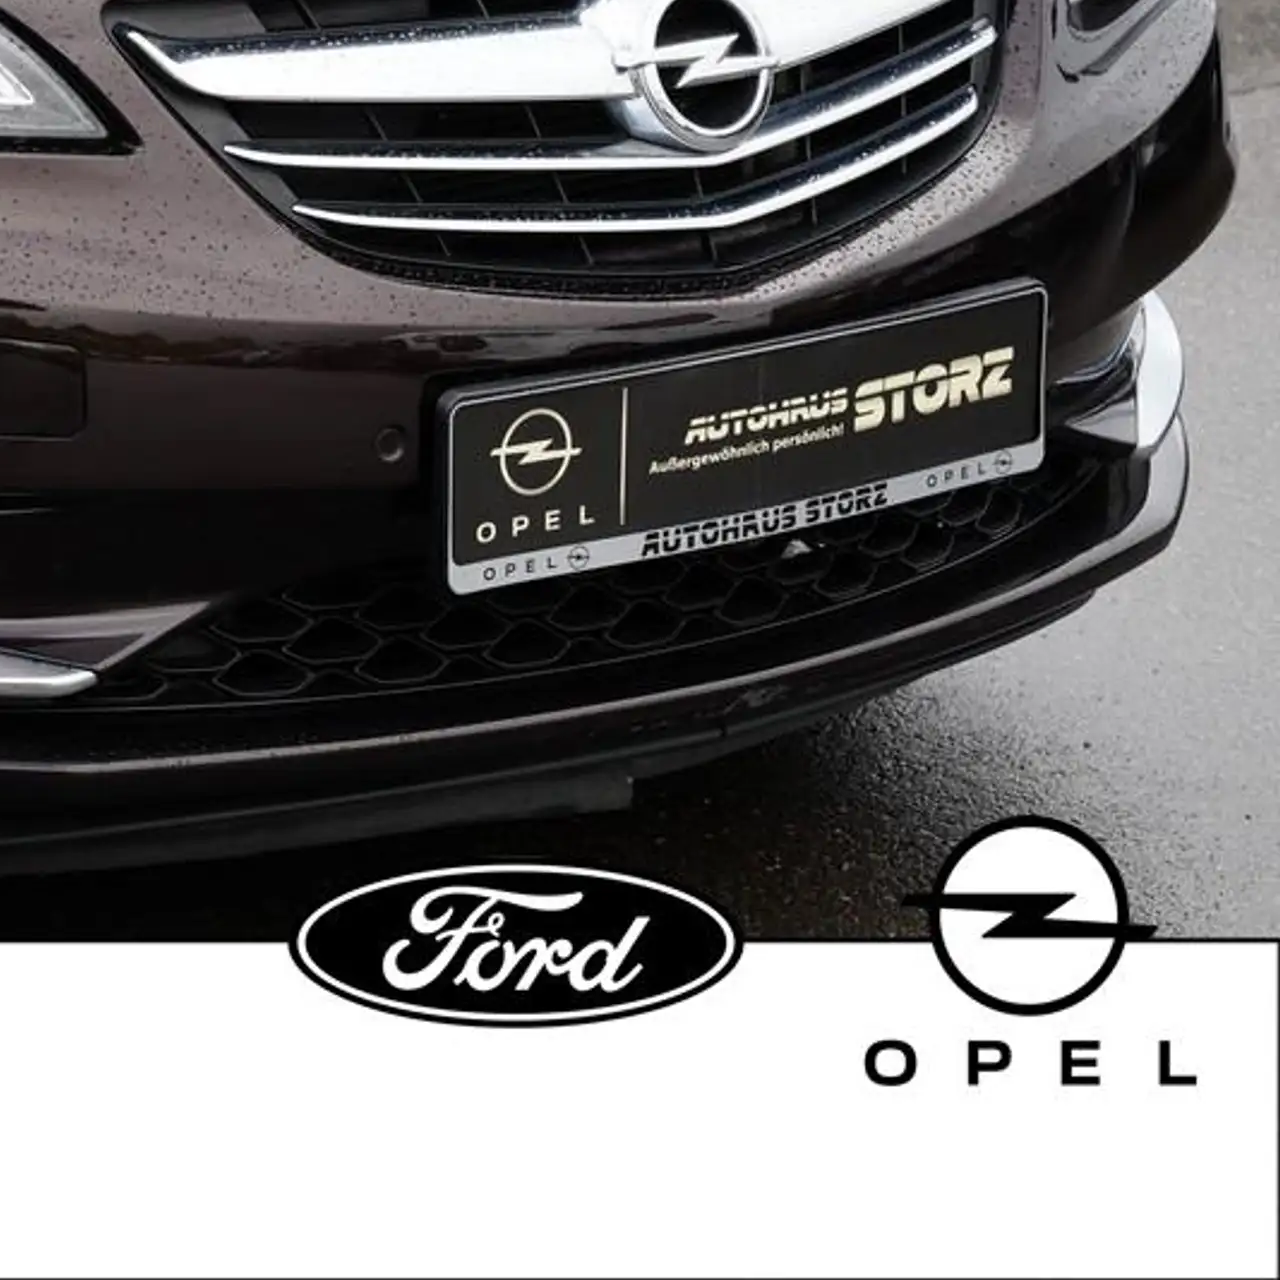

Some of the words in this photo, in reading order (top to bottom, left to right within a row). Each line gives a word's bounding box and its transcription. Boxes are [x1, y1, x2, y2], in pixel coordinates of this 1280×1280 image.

[684, 387, 849, 445] AUTOHAUS
[853, 346, 1015, 433] STORZ
[925, 462, 986, 488] OPEL
[475, 504, 596, 544] OPEL
[641, 504, 797, 557] AUTOHAUS
[804, 481, 888, 523] STORZ
[482, 557, 559, 581] OPEL
